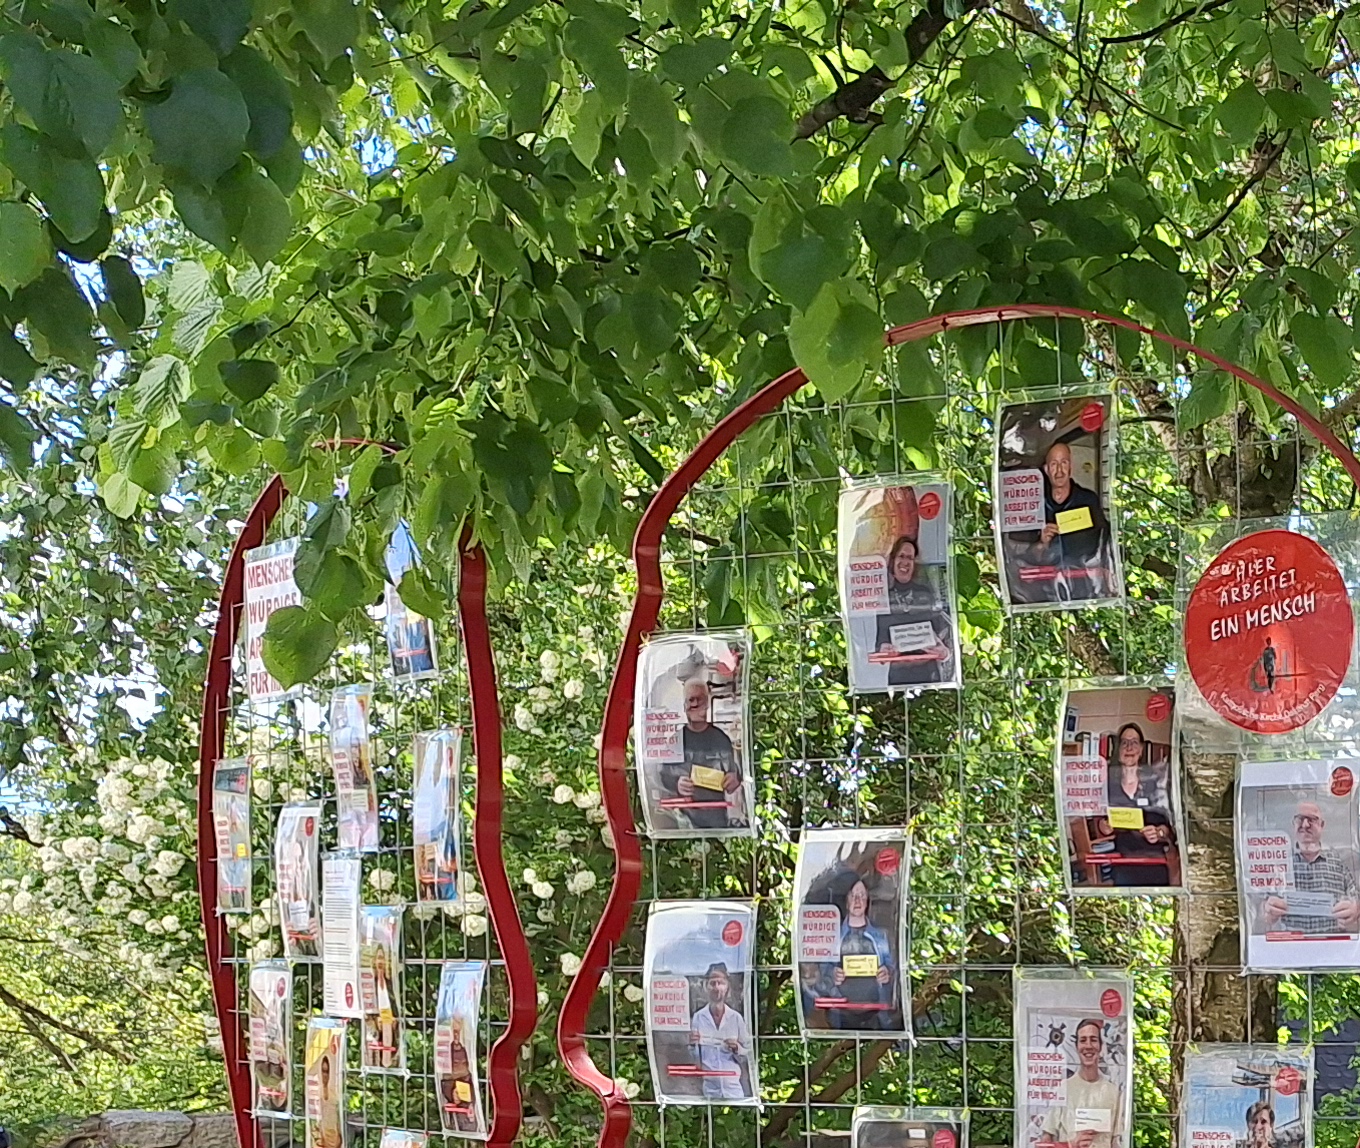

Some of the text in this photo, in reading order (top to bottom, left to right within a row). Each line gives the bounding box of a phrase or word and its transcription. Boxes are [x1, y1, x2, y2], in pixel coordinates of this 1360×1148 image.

[1004, 488, 1040, 498] WÜRDIGE
[1029, 501, 1040, 510] IST
[1005, 514, 1018, 525] FÜR
[1236, 556, 1276, 582] HIER
[1220, 569, 1296, 607] ARBEITET
[1211, 592, 1315, 640] EIN MENSCH
[250, 669, 268, 695] FÜR
[1247, 836, 1288, 845] MENSCHEN-
[1248, 849, 1287, 860] WÜRDIGE
[1251, 877, 1264, 886] FÜR
